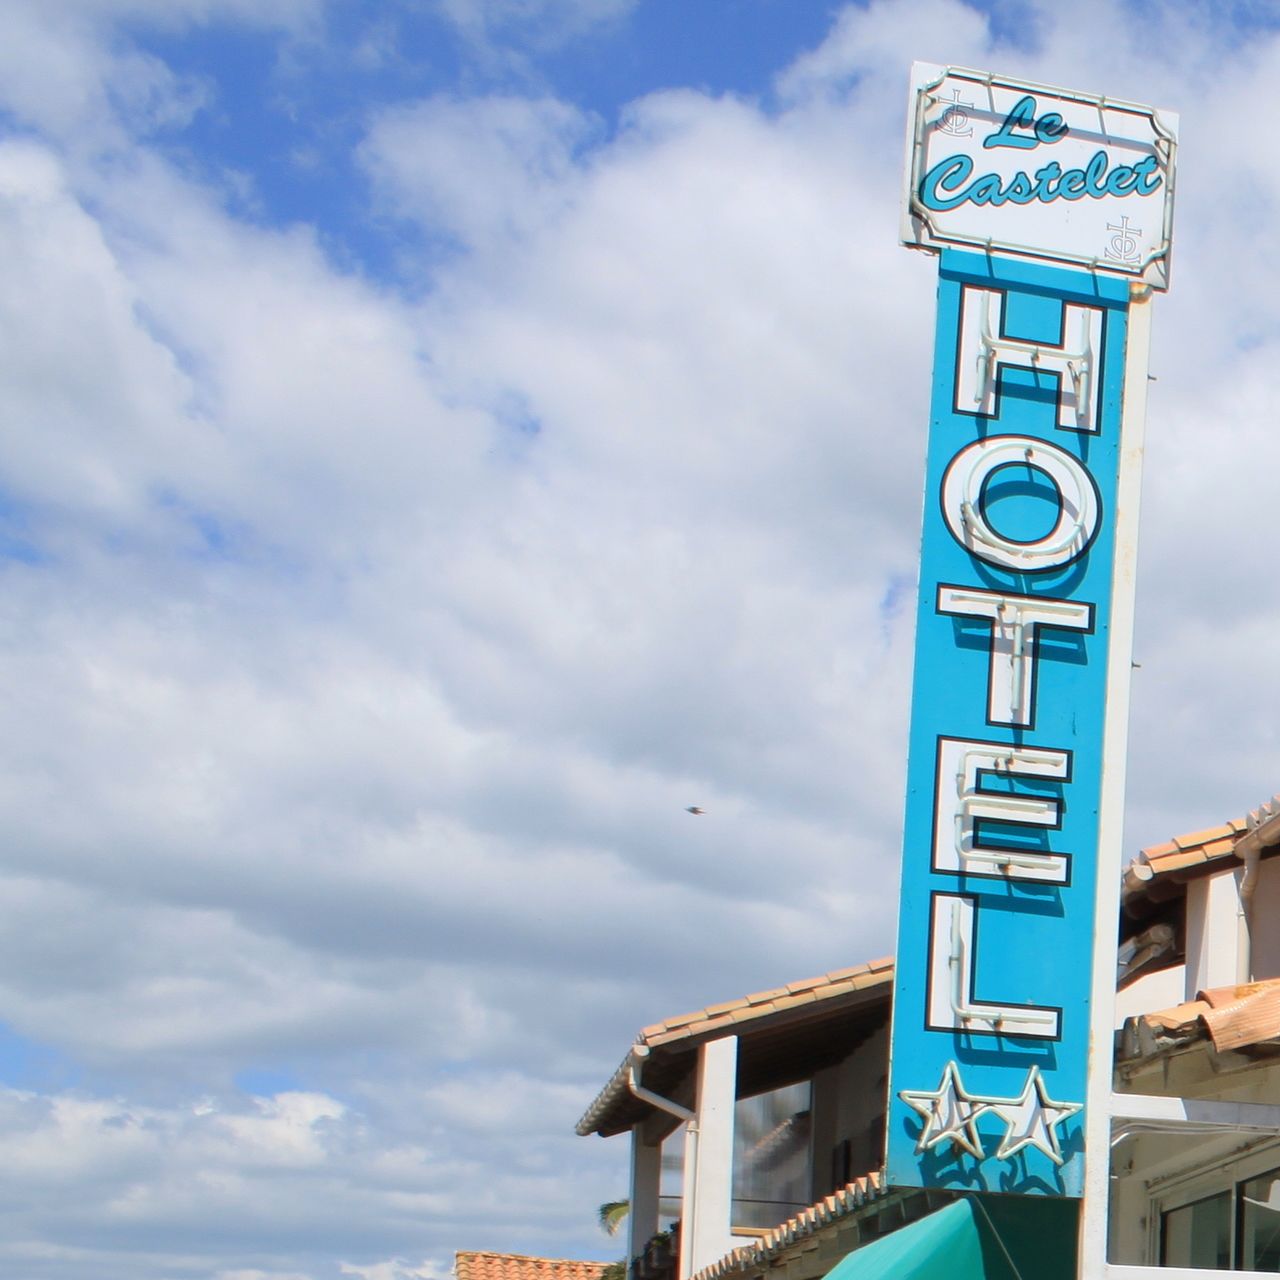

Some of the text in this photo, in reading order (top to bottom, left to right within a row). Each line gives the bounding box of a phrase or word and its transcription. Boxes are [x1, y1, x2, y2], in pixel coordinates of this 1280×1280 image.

[983, 95, 1069, 150] Le
[919, 150, 1162, 211] Castelet
[924, 284, 1103, 1041] HOTEL
